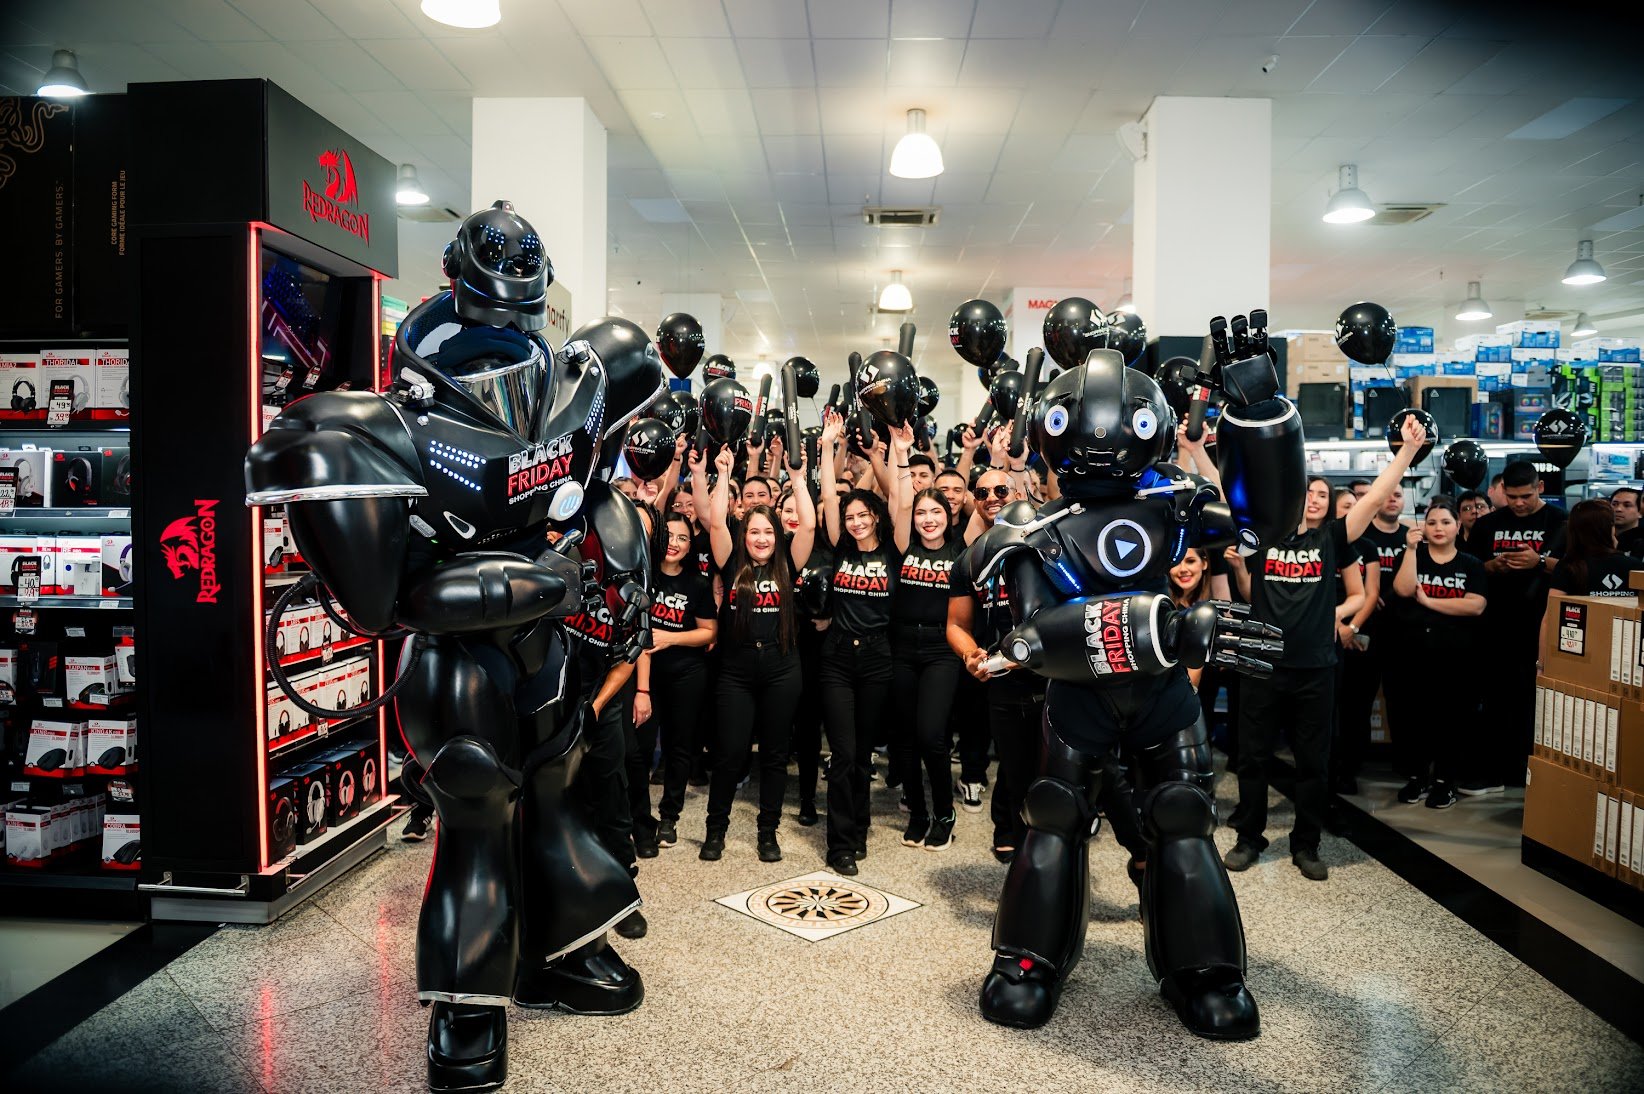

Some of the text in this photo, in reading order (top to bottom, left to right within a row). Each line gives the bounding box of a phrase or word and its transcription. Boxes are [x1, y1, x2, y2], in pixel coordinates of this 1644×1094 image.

[303, 179, 369, 248] REDRAGON
[54, 233, 63, 246] BY
[54, 298, 63, 319] FOR
[508, 434, 573, 475] BLACK
[508, 453, 574, 496] FRIDAY
[550, 475, 573, 488] CHINA
[1494, 530, 1546, 541] BLACK
[194, 500, 221, 604] REDRAGON
[1266, 547, 1322, 564] BLACK
[838, 560, 888, 578] BLACK
[904, 554, 954, 571] BLACK
[1264, 559, 1322, 578] FRIDAY
[834, 572, 888, 591] FRIDAY
[1418, 574, 1466, 590] BLACK
[834, 586, 890, 598] SHOPPING CHINA
[663, 620, 684, 628] CHINA
[1084, 602, 1113, 674] BLACK
[1102, 600, 1131, 672] FRIDAY
[1122, 598, 1139, 671] SHOPPING CHINA
